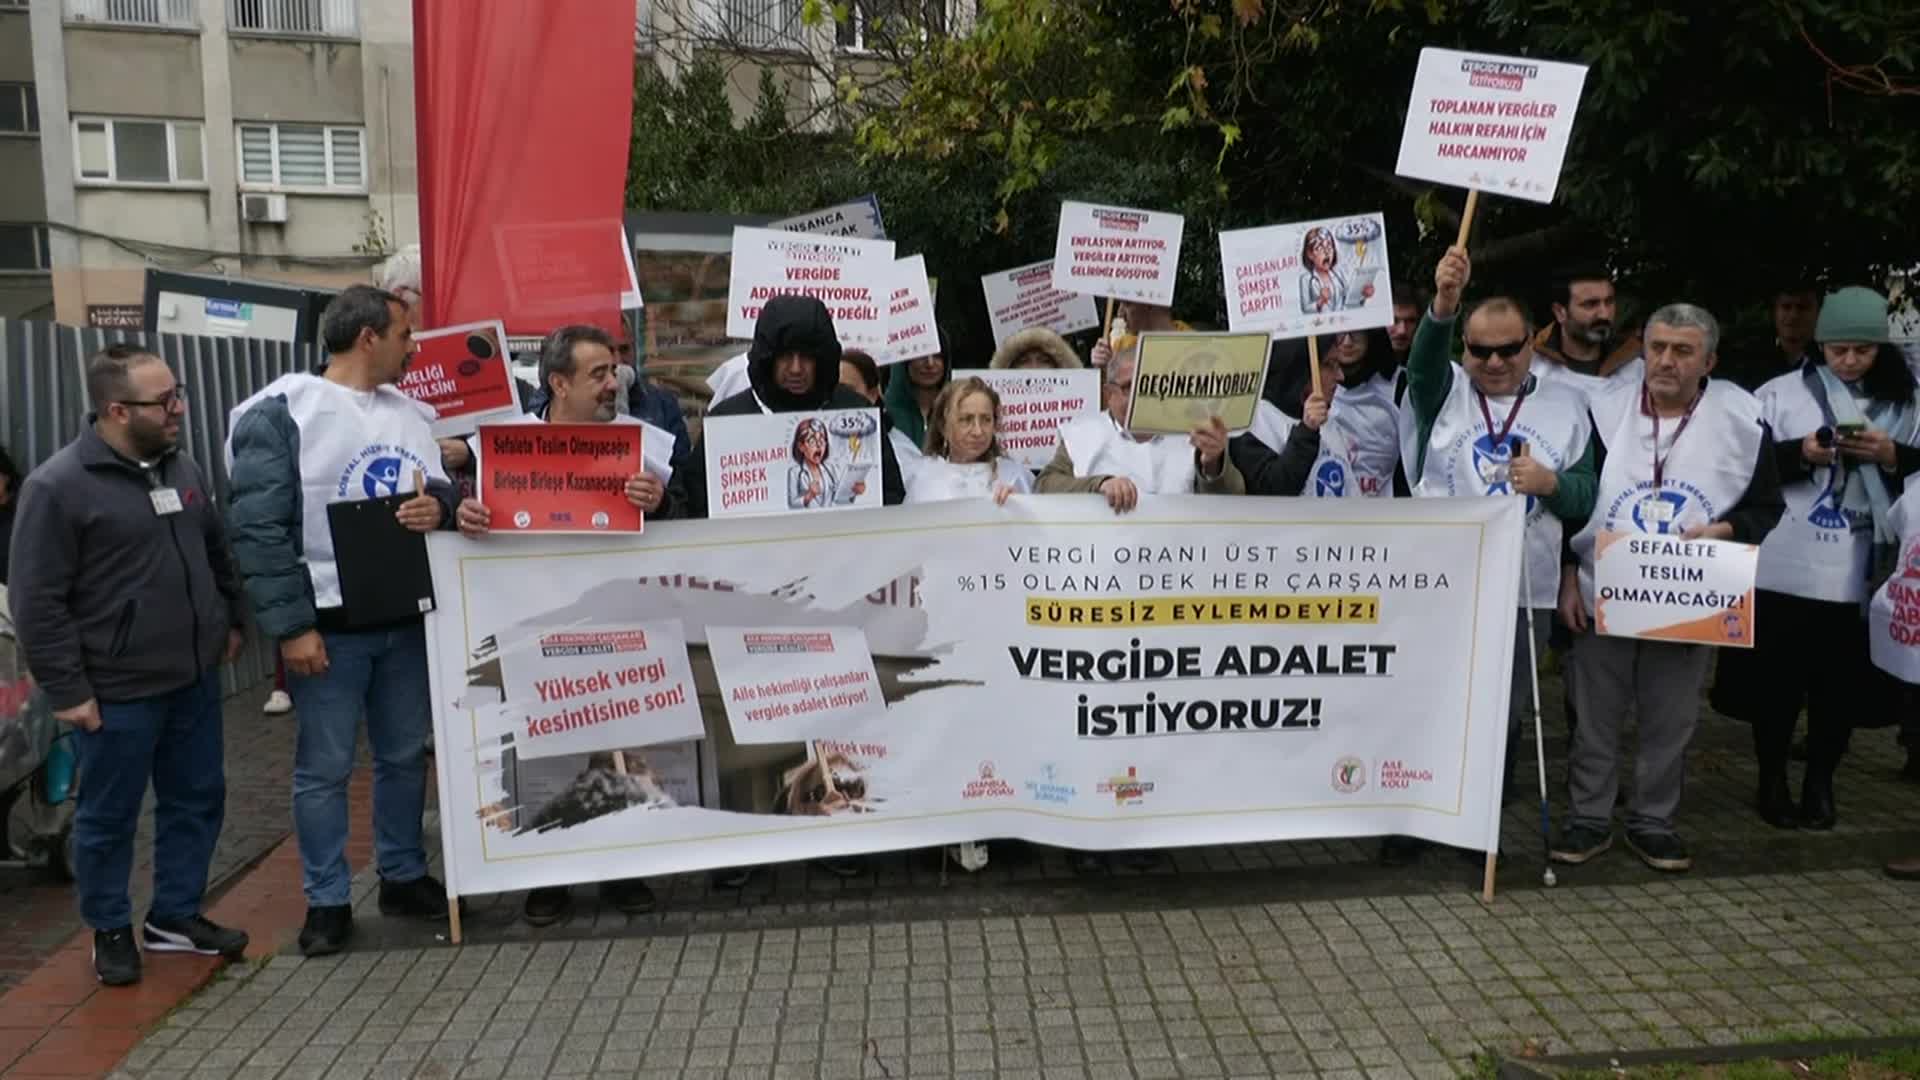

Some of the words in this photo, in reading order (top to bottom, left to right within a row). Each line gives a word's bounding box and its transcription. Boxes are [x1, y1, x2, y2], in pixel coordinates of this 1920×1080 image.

[1430, 99, 1496, 117] TOPLANAN
[1499, 101, 1557, 118] VERGİLER
[1429, 122, 1473, 136] HALKIN
[1476, 124, 1518, 140] REFAHI
[1521, 125, 1547, 141] İÇİN
[1438, 143, 1527, 162] HARCANMIYOR
[1346, 223, 1369, 235] 35%
[1071, 236, 1122, 250] ENFLASYON
[1124, 238, 1167, 251] ARTIYOR,
[1074, 251, 1116, 263] VERGİLER
[1118, 253, 1160, 266] ARTIYOR,
[1236, 256, 1297, 281] ÇALIŞANLARI
[785, 265, 840, 281] VERGİDE
[1071, 265, 1113, 278] GELİRİMİZ
[1115, 267, 1159, 280] DÜŞÜYOR
[802, 284, 872, 302] İSTİYORUZ,
[1238, 276, 1280, 298] ŞİMŞEK
[838, 305, 878, 321] DEĞİL!
[1240, 296, 1282, 317] ÇARPTI!
[403, 379, 457, 400] EKİLSİN!
[1138, 370, 1260, 402] GEÇİNEMİYORUZ!
[1001, 401, 1027, 416] ERGİ
[1030, 401, 1059, 413] OLUR
[1061, 398, 1084, 411] MU?
[841, 416, 865, 430] 35%
[494, 436, 533, 456] Sefalete
[536, 437, 567, 455] Teslim
[570, 437, 631, 462] Olmayacağız
[720, 447, 788, 470] ÇALIŞANLARI
[493, 471, 528, 494] Birleşe
[531, 471, 564, 495] Birleşe
[720, 467, 767, 489] ŞİMŞEK
[722, 487, 769, 509] ÇARPTI!
[1008, 544, 1097, 564] VERGİ
[1114, 545, 1206, 564] ORANI
[1225, 543, 1278, 563] ÜST
[1296, 546, 1389, 563] SINIRI
[1629, 540, 1717, 558] SEFALETE
[957, 574, 1007, 592] %15
[1023, 573, 1122, 592] OLANA
[1139, 573, 1195, 591] DEK
[1212, 573, 1270, 590] HER
[1287, 573, 1450, 594] ÇARŞAMBA
[1640, 564, 1704, 582] TESLİM
[1601, 586, 1745, 609] OLMAYACAĞIZ!
[1030, 601, 1156, 623] SÜRESİZ
[1173, 599, 1377, 620] EYLEMDEYİZ!
[1009, 638, 1201, 682] VERGİDE
[1215, 645, 1396, 677] ADALET
[534, 669, 611, 702] Yüksek
[615, 657, 667, 687] vergi
[733, 686, 755, 702] Aile
[757, 679, 812, 699] hekimliği
[814, 671, 870, 692] çalışanları
[526, 697, 641, 738] kesintisine
[645, 683, 686, 712] son!
[745, 703, 791, 722] vergide
[793, 697, 829, 714] adalet
[830, 689, 868, 707] istiyor!
[1077, 691, 1323, 737] İSTİYORUZ!
